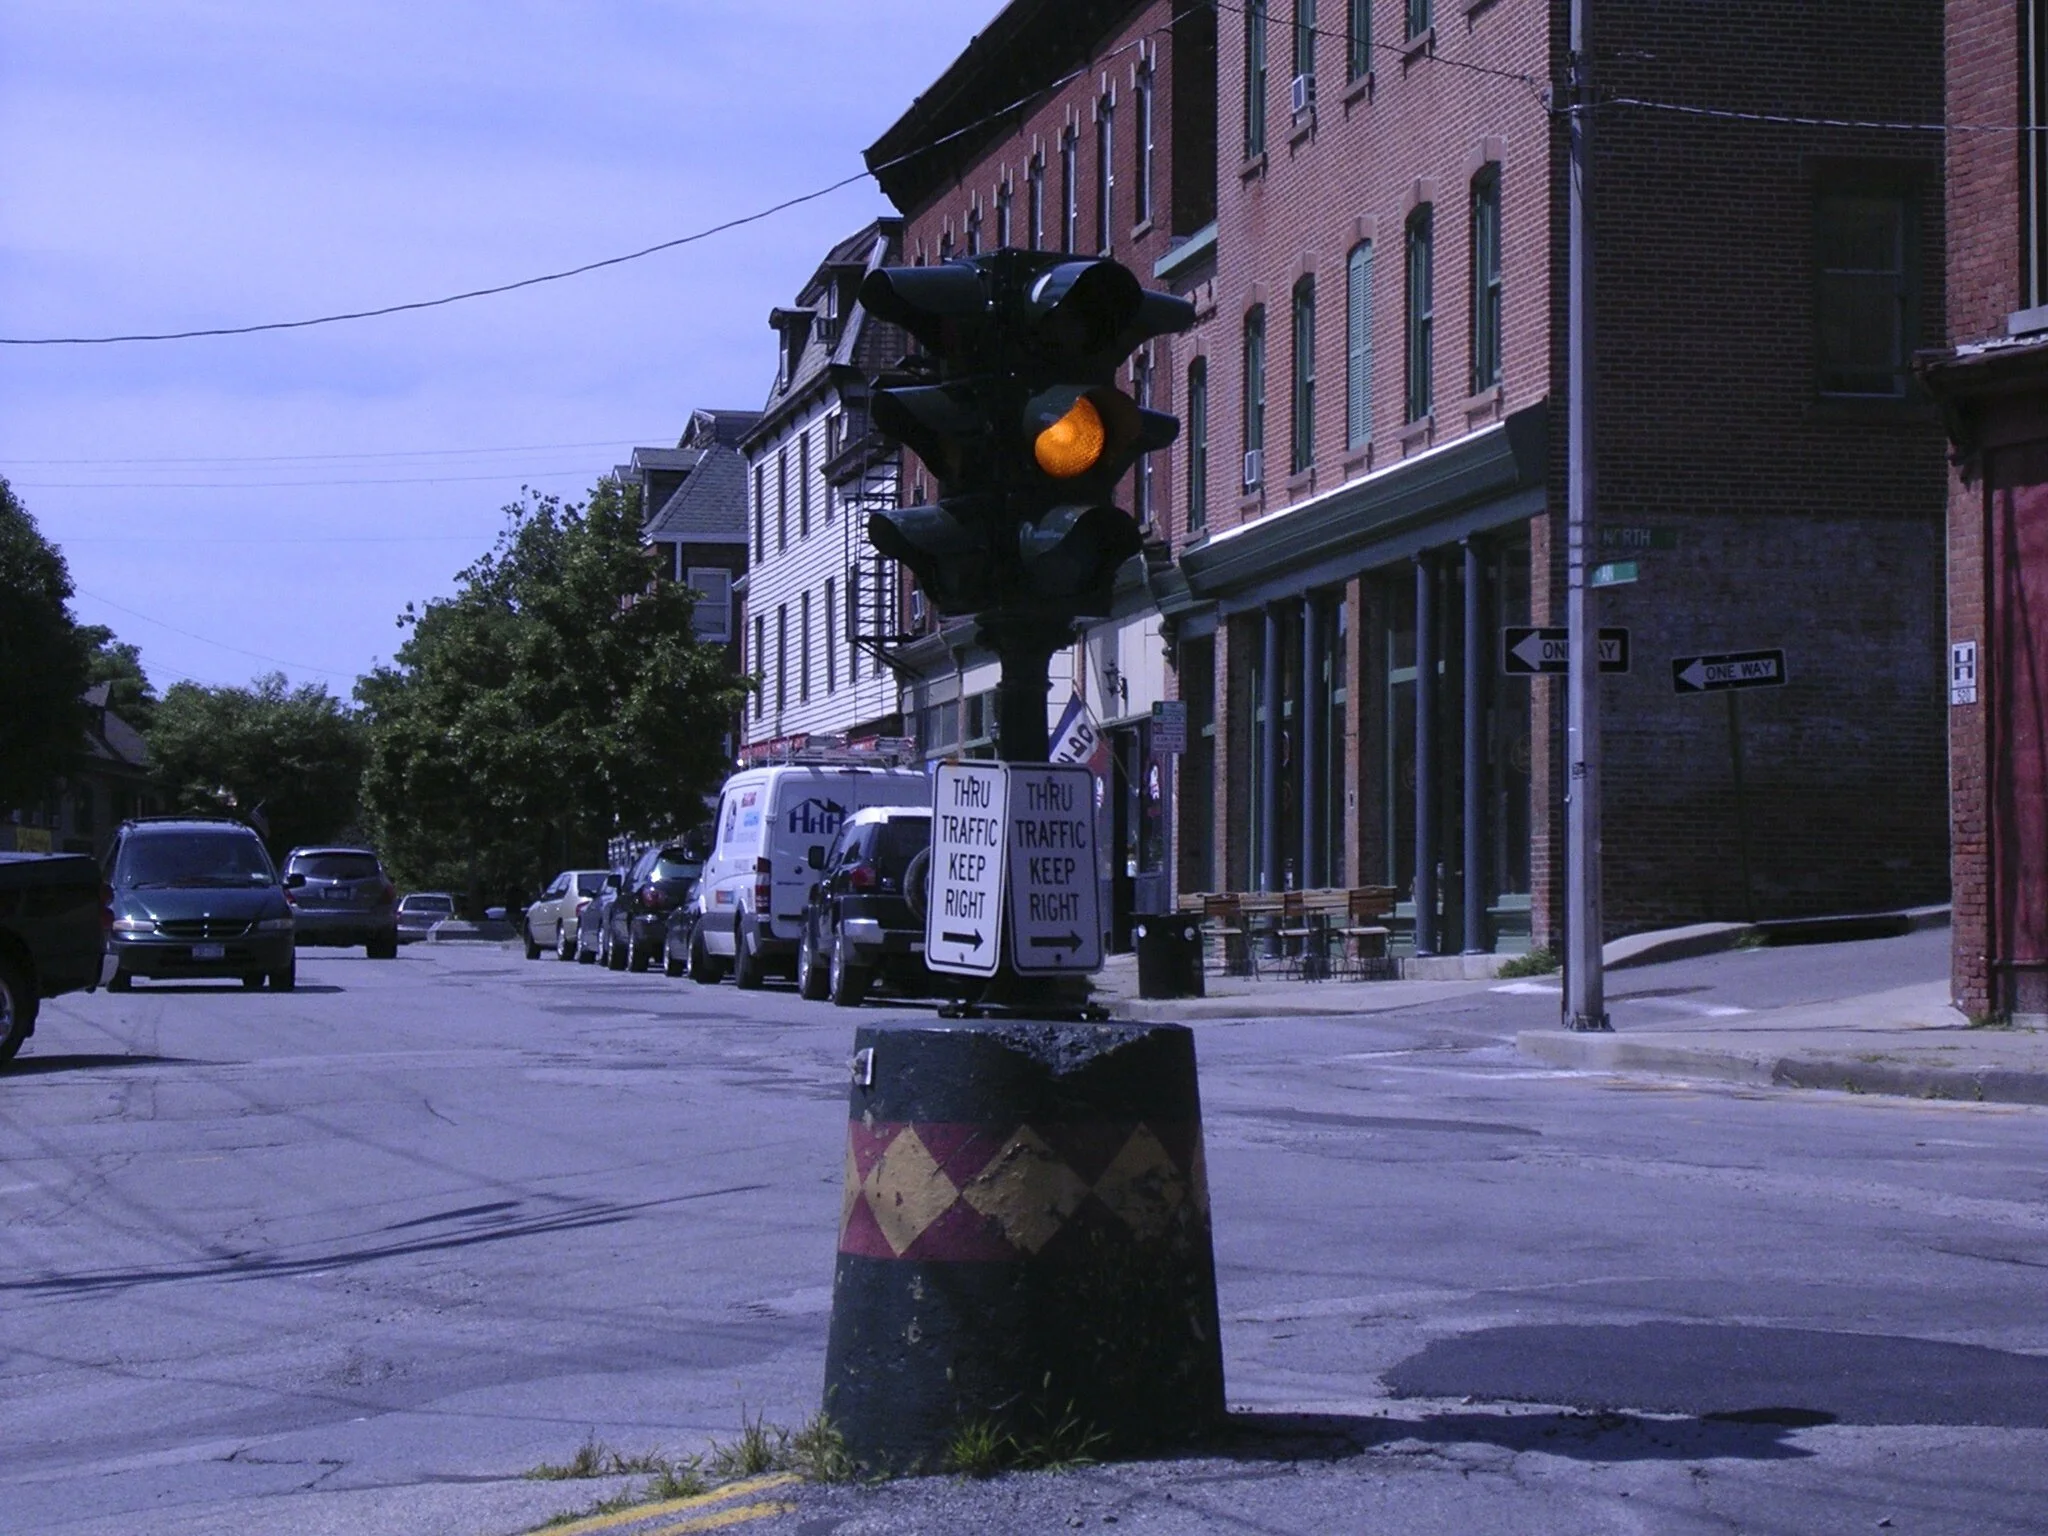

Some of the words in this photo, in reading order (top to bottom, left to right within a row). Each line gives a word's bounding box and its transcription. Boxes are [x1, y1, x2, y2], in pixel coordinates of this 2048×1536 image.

[1706, 665, 1736, 680] ONE
[1740, 662, 1772, 677] WAY
[1955, 648, 1973, 680] H
[953, 778, 991, 809] THRU
[1026, 782, 1073, 812] THRU
[942, 815, 998, 847] TRAFFIC
[1015, 819, 1086, 849] TRAFFIC
[949, 852, 986, 882] KEEP
[1029, 857, 1076, 885] KEEP
[945, 889, 986, 920] RIGHT
[1029, 893, 1079, 922] RIGHT
